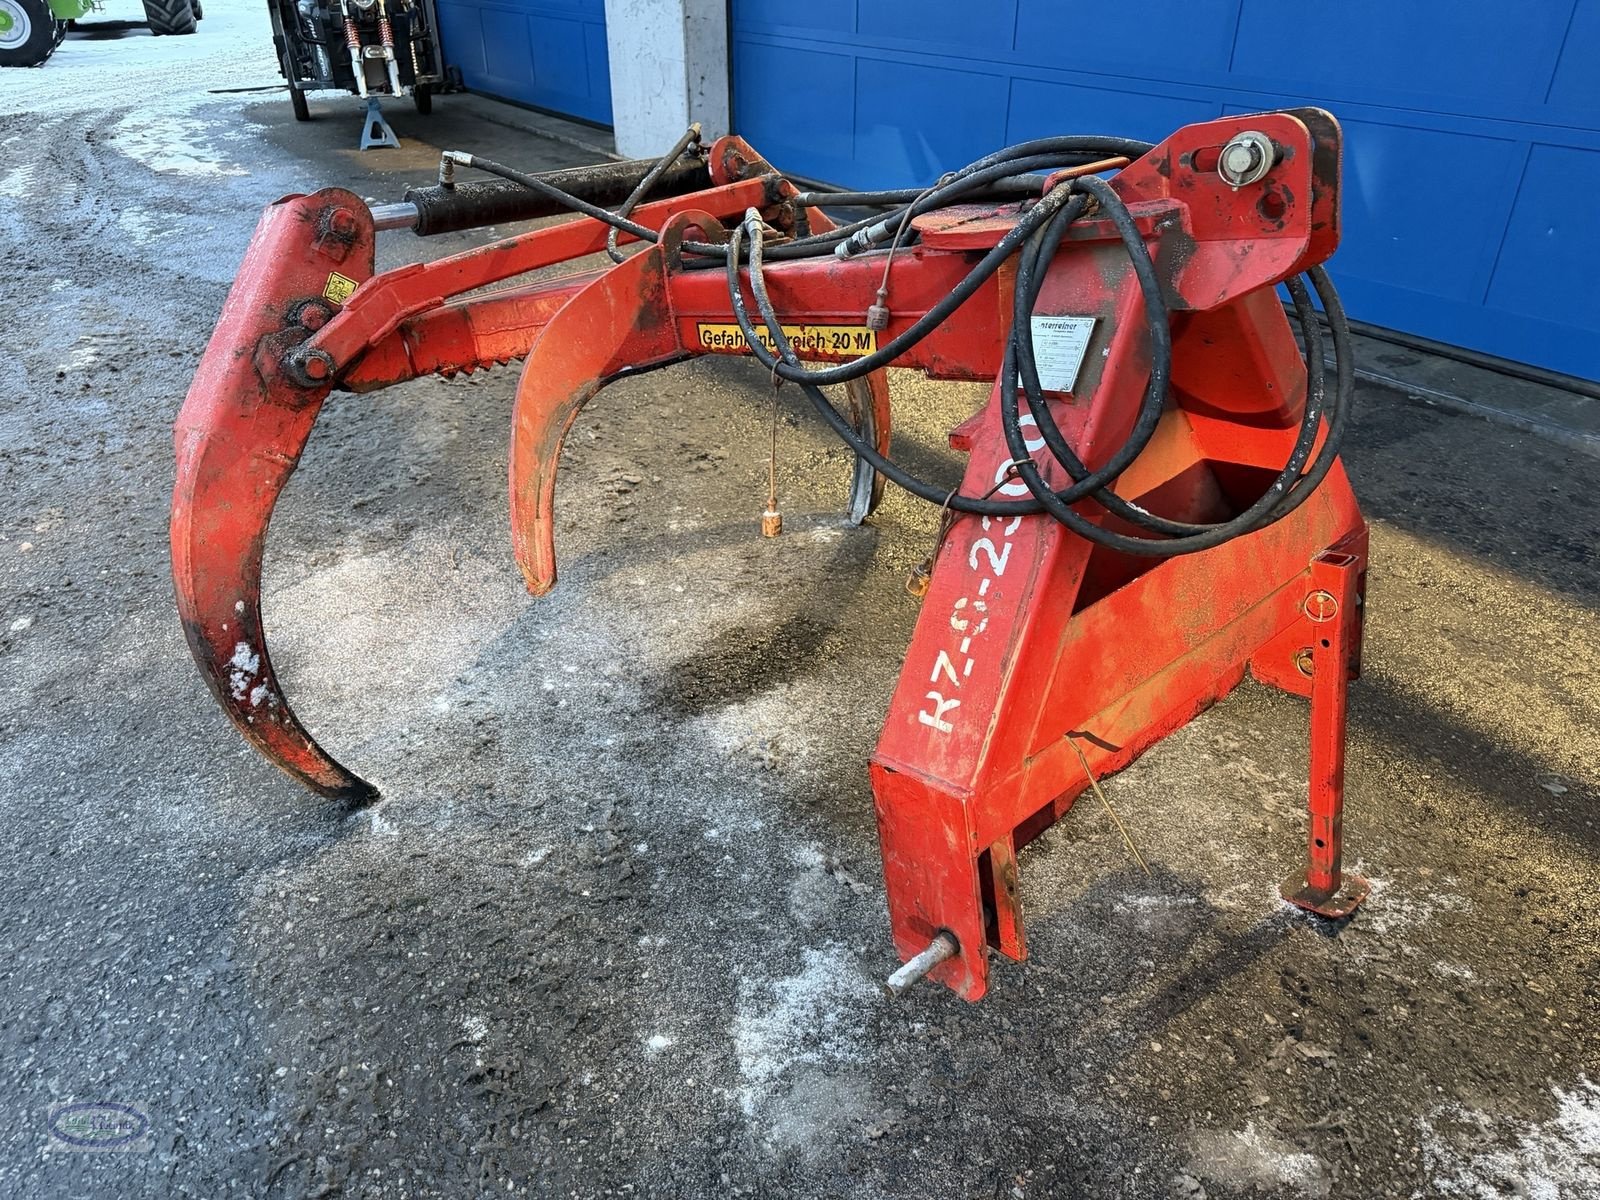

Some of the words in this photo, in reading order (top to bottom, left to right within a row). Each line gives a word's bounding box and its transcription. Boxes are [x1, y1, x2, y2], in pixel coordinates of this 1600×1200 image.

[702, 329, 826, 349] Gefahrnbreich
[831, 332, 851, 350] 20
[856, 332, 871, 350] M
